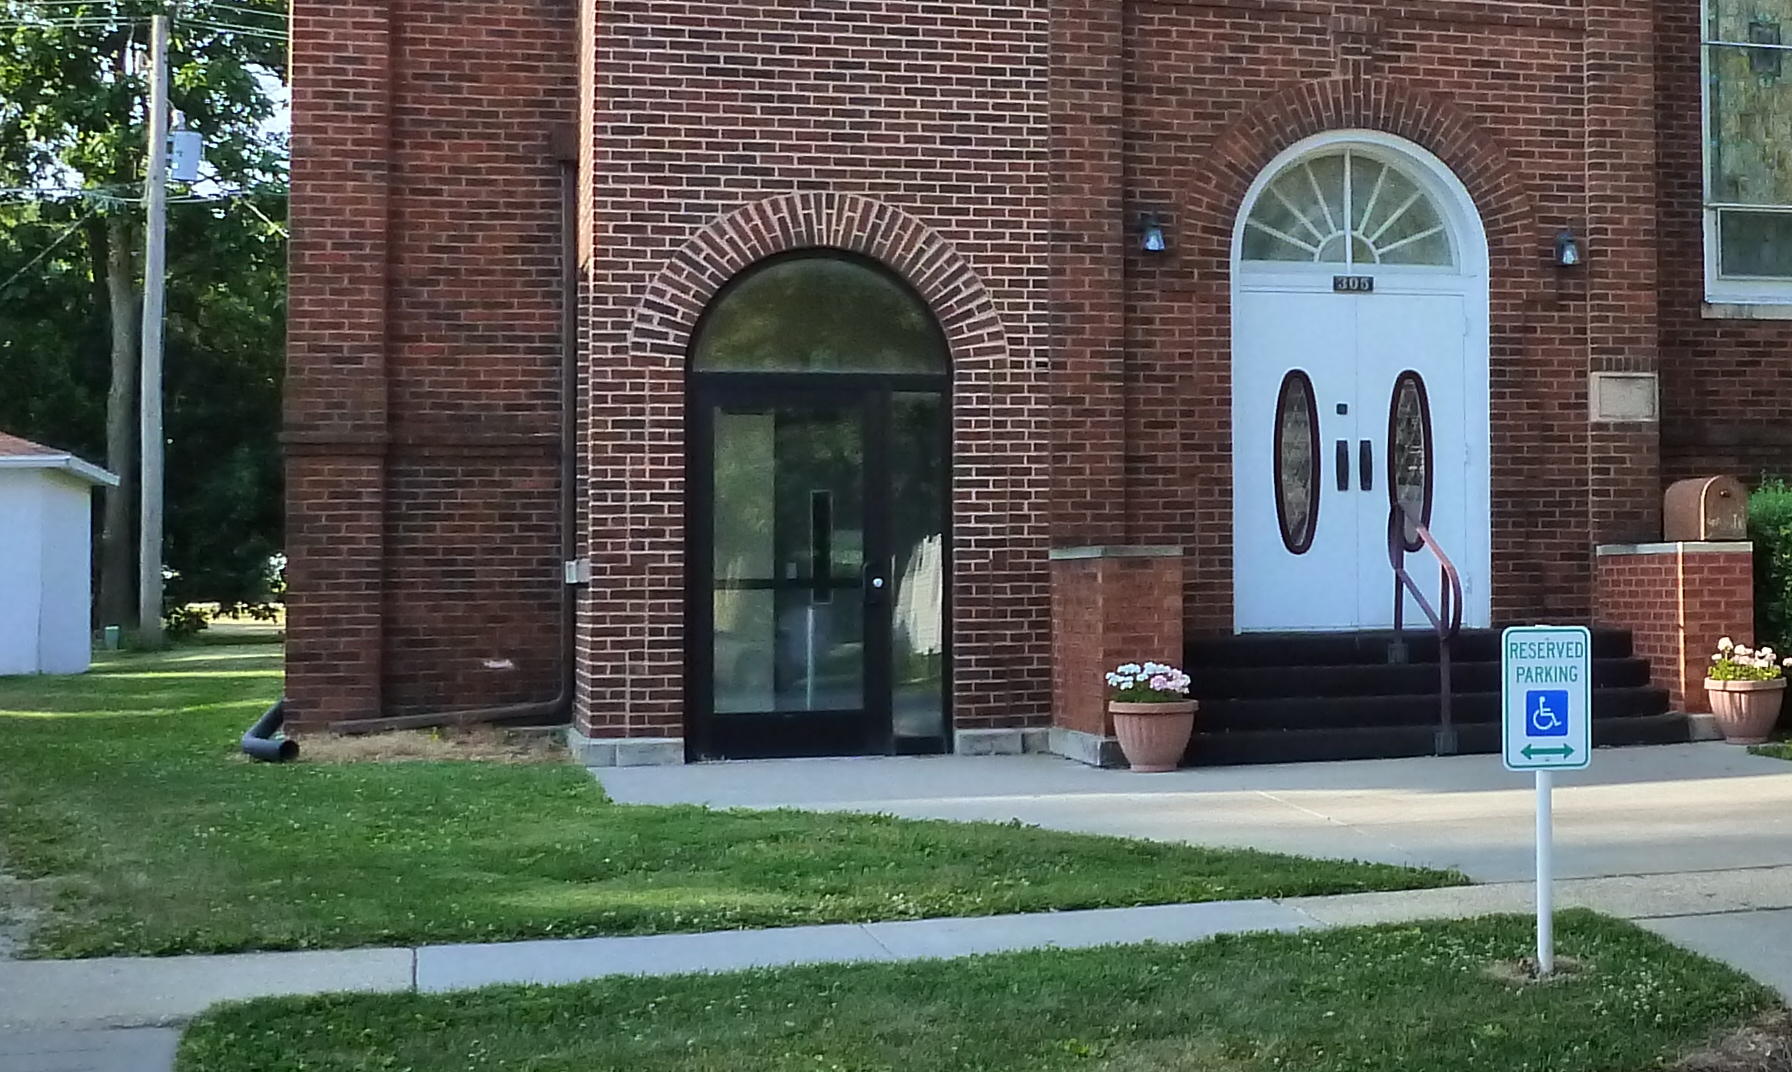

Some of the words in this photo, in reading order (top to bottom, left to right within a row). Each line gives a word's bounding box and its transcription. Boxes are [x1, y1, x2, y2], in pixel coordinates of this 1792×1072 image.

[1335, 277, 1370, 290] 305
[1509, 641, 1584, 659] RESERVED
[1516, 665, 1579, 683] PARKING
